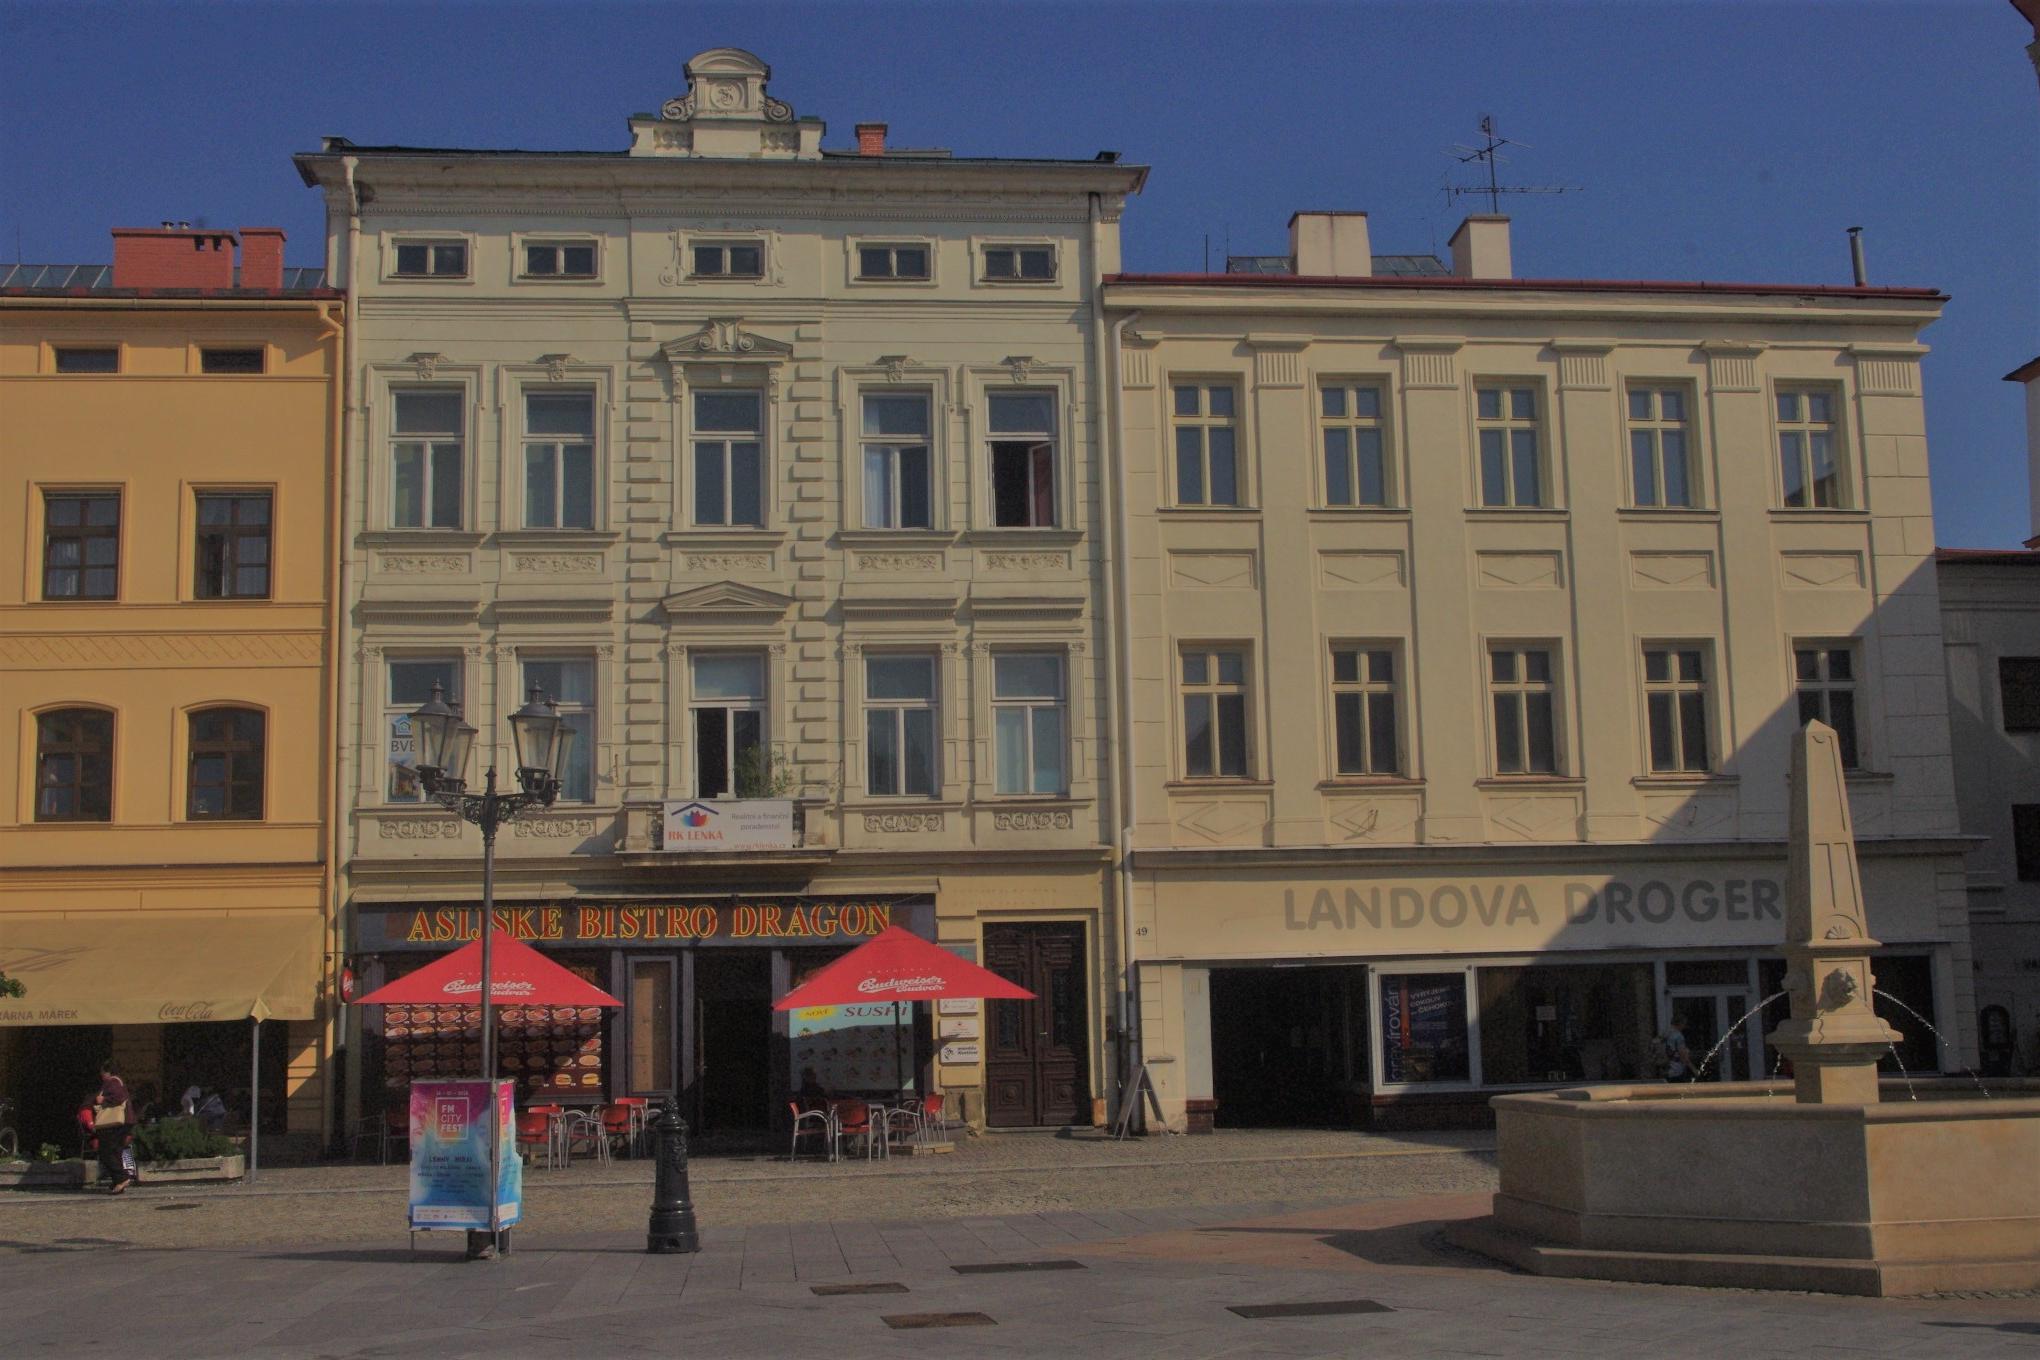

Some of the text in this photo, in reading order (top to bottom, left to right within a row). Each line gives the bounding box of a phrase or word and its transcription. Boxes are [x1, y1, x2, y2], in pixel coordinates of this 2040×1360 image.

[668, 831, 684, 841] RK
[1284, 883, 1540, 931] LANDOVA
[577, 903, 718, 939] BISTRO
[731, 901, 892, 938] DRAGON
[1135, 927, 1148, 937] 49
[443, 979, 537, 994] Budeiser
[858, 976, 947, 994] Budweiser
[39, 1009, 79, 1020] MAREK
[441, 1104, 455, 1113] FM
[440, 1114, 462, 1123] CITY
[441, 1124, 464, 1133] FEST
